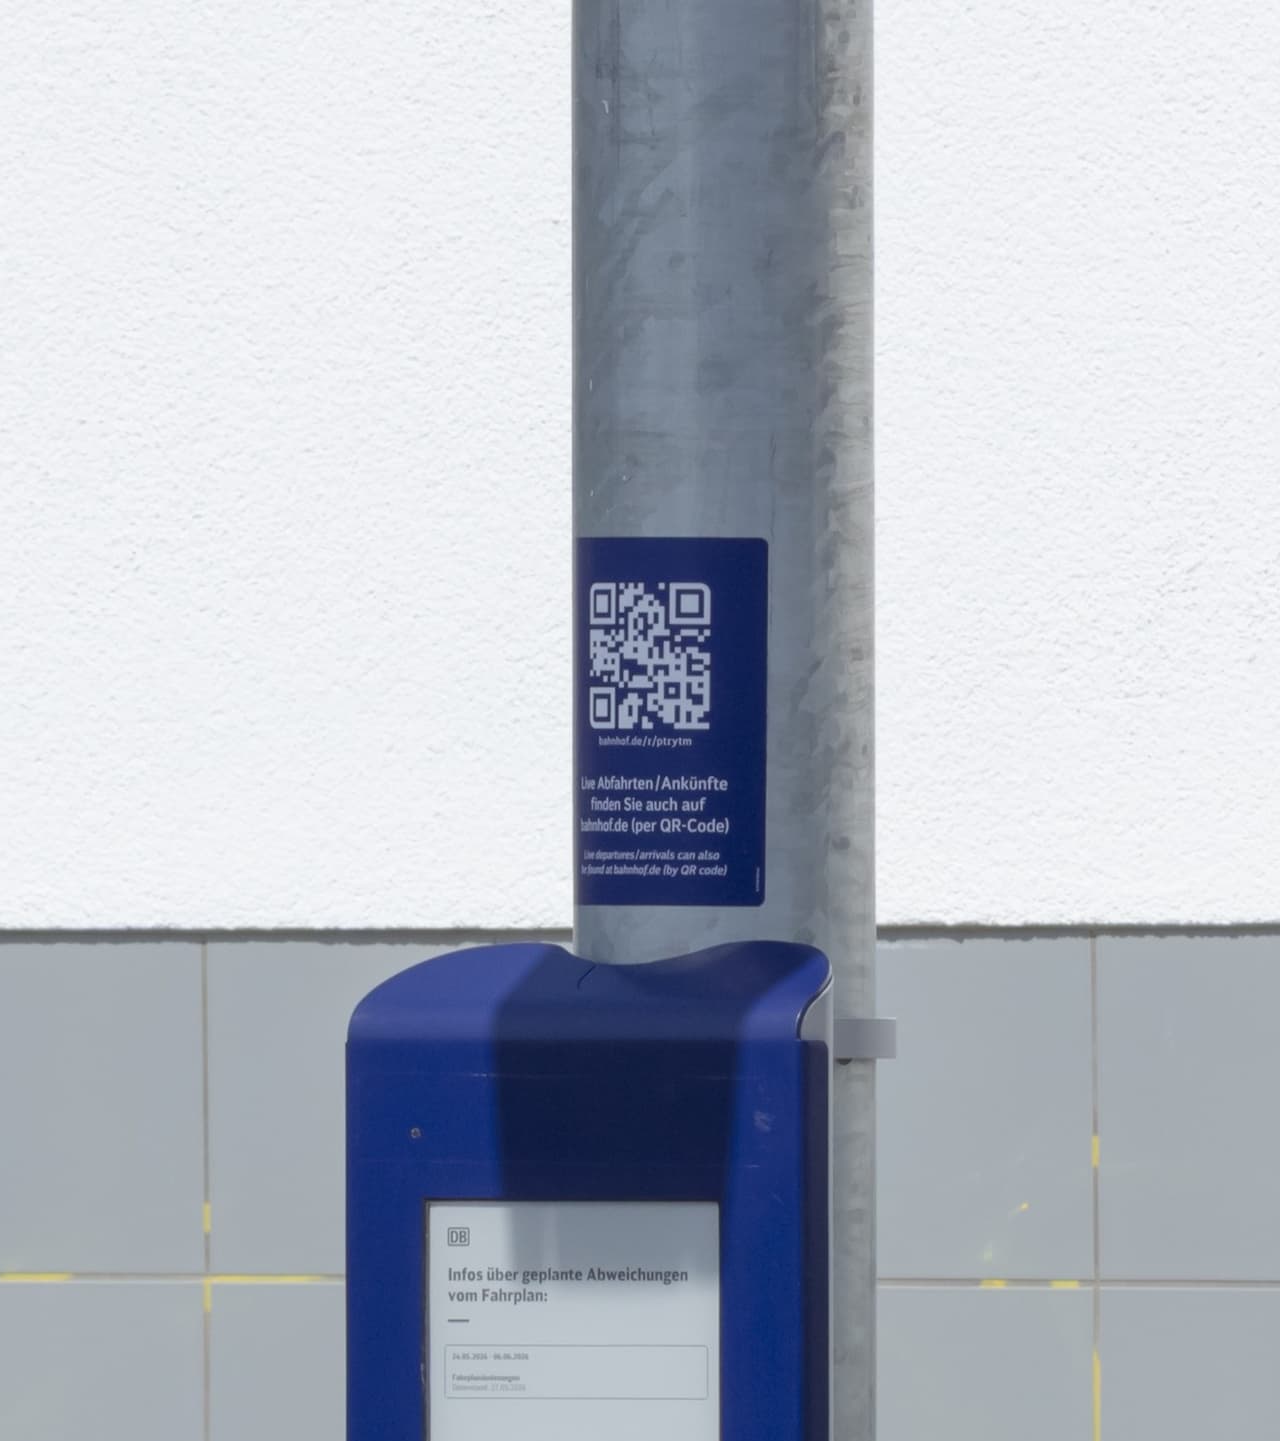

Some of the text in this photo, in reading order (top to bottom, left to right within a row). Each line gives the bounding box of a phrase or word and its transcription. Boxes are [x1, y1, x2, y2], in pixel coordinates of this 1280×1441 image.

[591, 797, 706, 811] finden Sie auch auf
[631, 817, 656, 834] (per
[660, 817, 729, 833] QR-Code)
[677, 852, 695, 860] can
[698, 850, 720, 860] also
[663, 866, 679, 877] (by
[681, 866, 696, 876] QR
[699, 865, 727, 876] code)
[449, 1229, 469, 1245] DB
[448, 1267, 688, 1285] Infos über geplante Abweichungen
[448, 1288, 548, 1305] vom Fahrplan:
